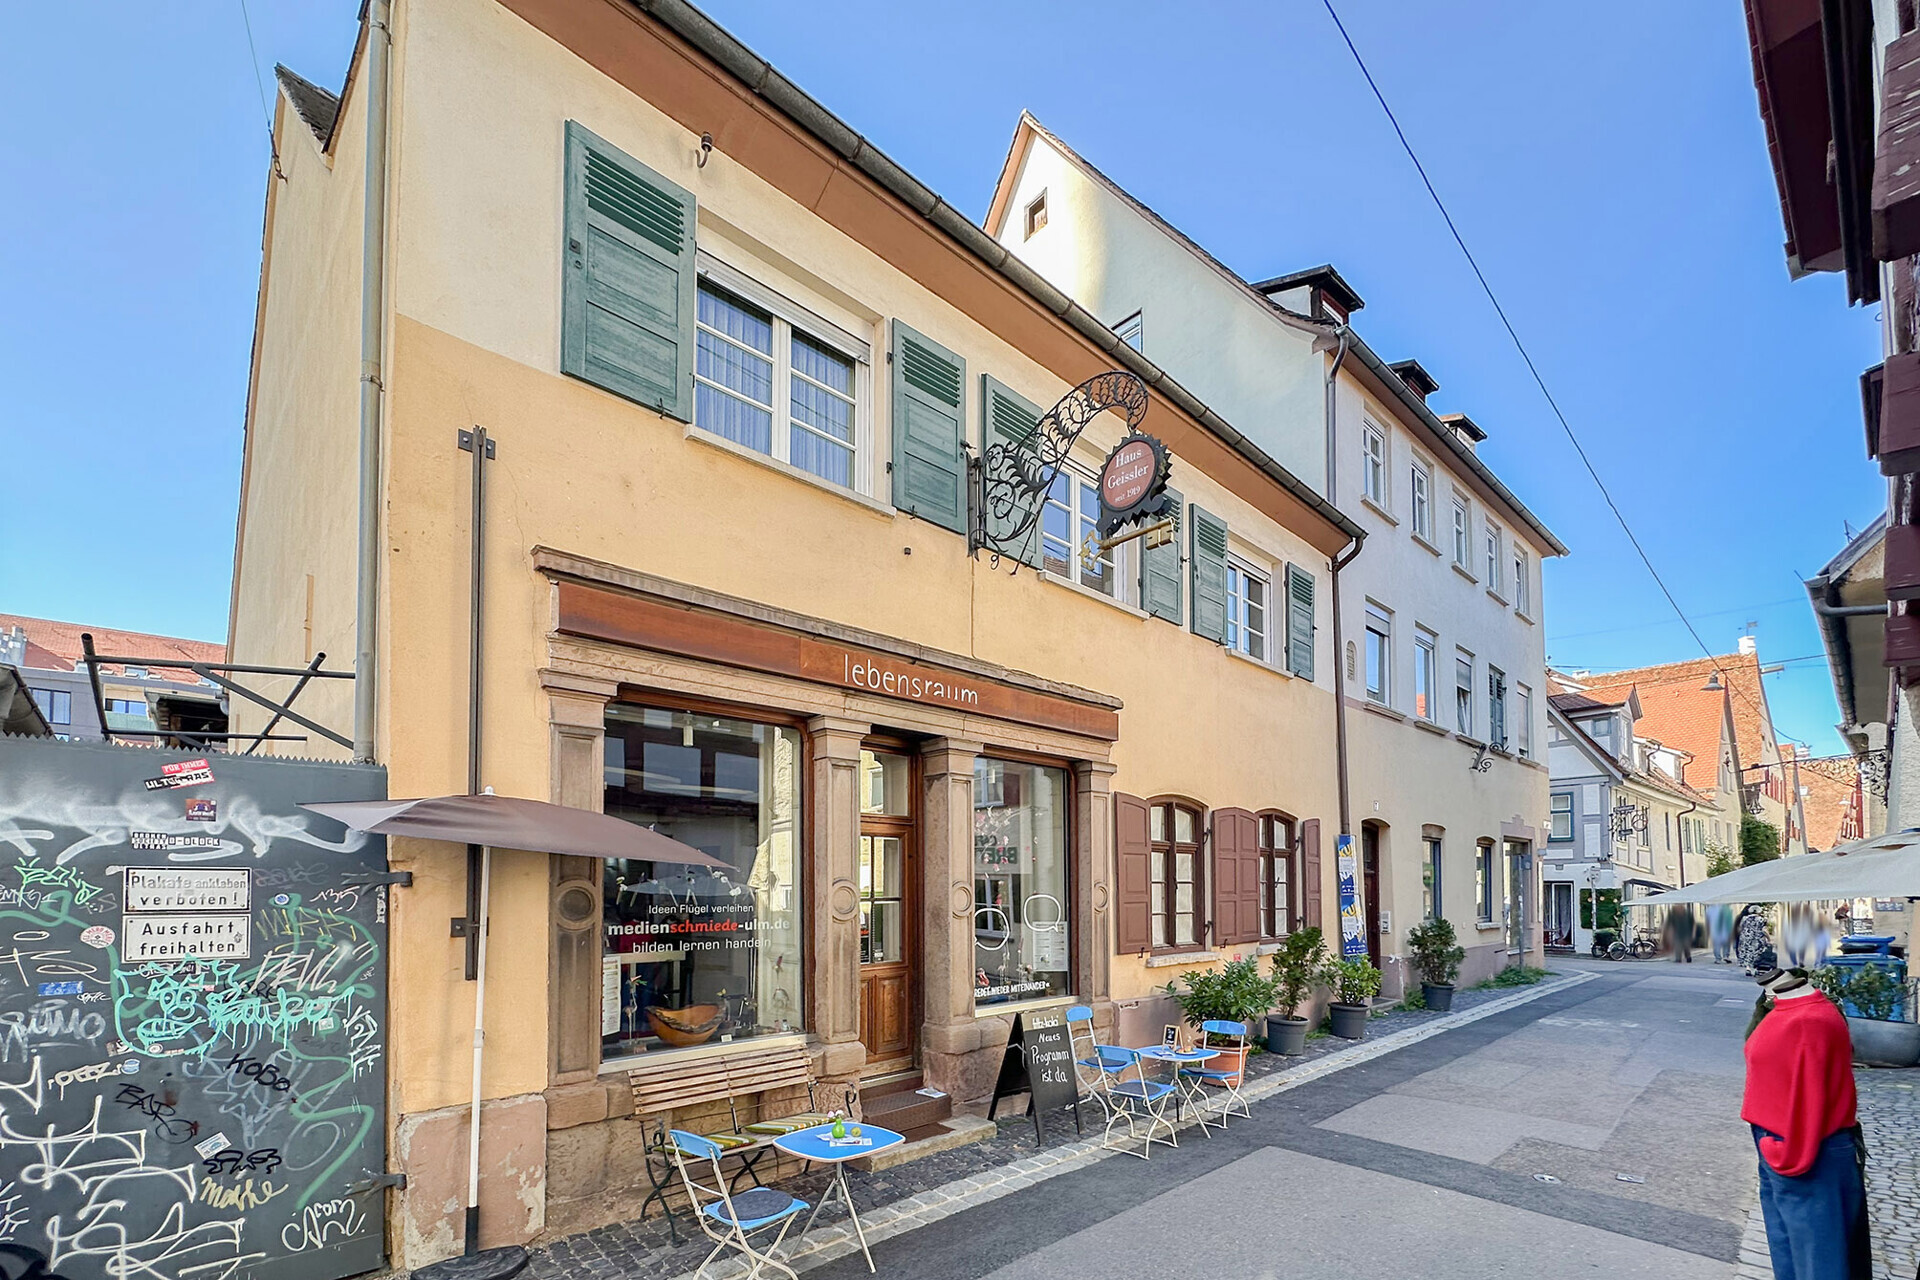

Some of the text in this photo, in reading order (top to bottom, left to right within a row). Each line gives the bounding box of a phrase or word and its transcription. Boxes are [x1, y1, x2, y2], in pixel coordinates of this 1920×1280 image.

[1114, 449, 1142, 468] Haus
[1107, 465, 1148, 489] Geissler
[844, 653, 978, 705] lebensraum
[131, 875, 246, 889] Plakate ankleben
[648, 903, 754, 915] Ideen Flügel verleihen
[142, 921, 234, 936] Ausfahrt
[608, 918, 790, 935] medienschmiede-ulm.de
[140, 940, 235, 956] freihalten
[632, 937, 771, 953] bilden lernen handeln
[1038, 1033, 1061, 1043] Neues
[1031, 1045, 1070, 1066] Programm
[1041, 1066, 1068, 1083] ist da
